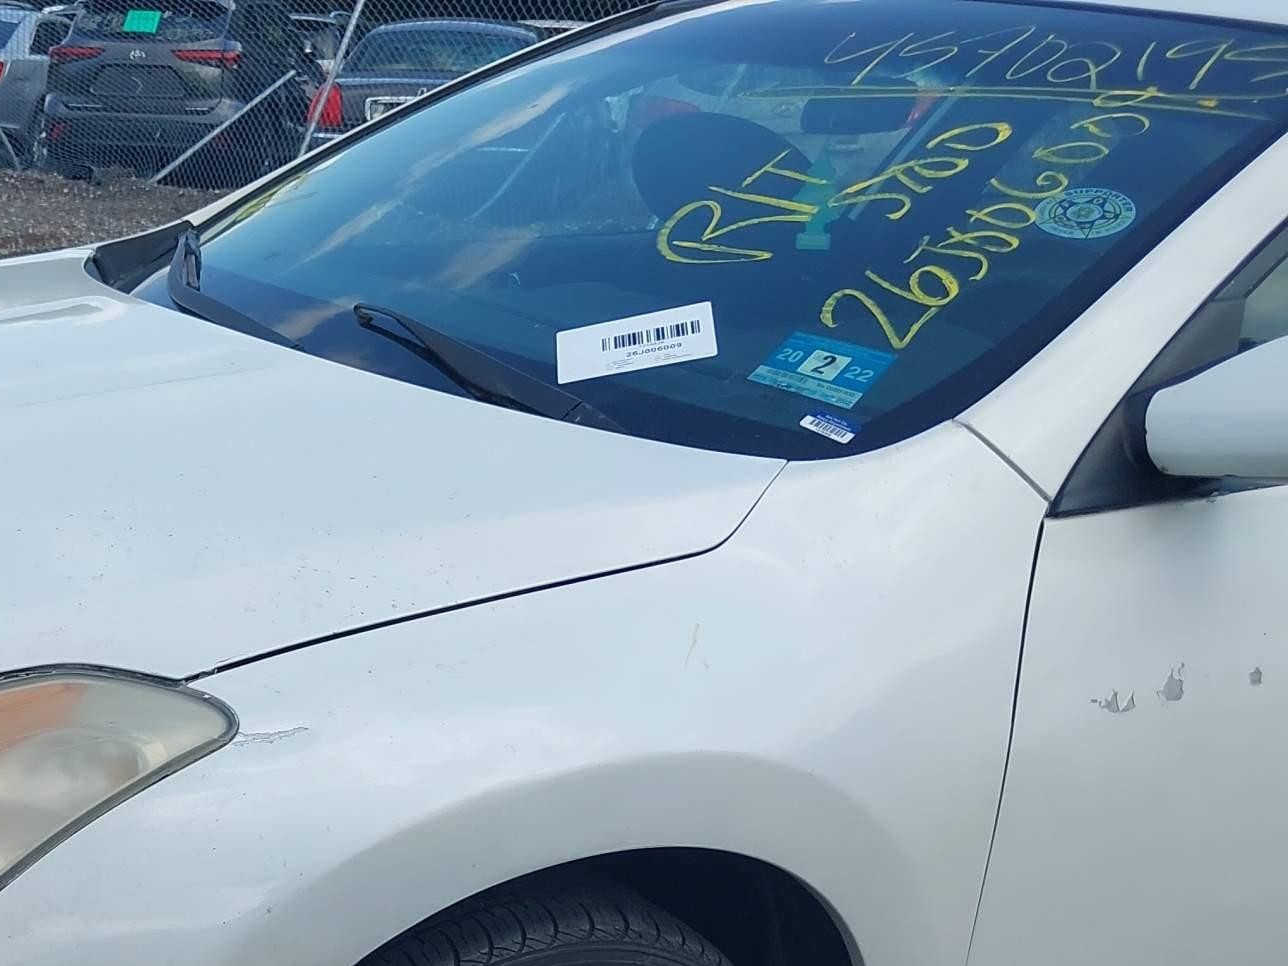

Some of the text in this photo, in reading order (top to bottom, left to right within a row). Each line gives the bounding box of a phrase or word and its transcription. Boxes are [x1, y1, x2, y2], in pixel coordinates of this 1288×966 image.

[775, 347, 874, 383] 20 2 22
